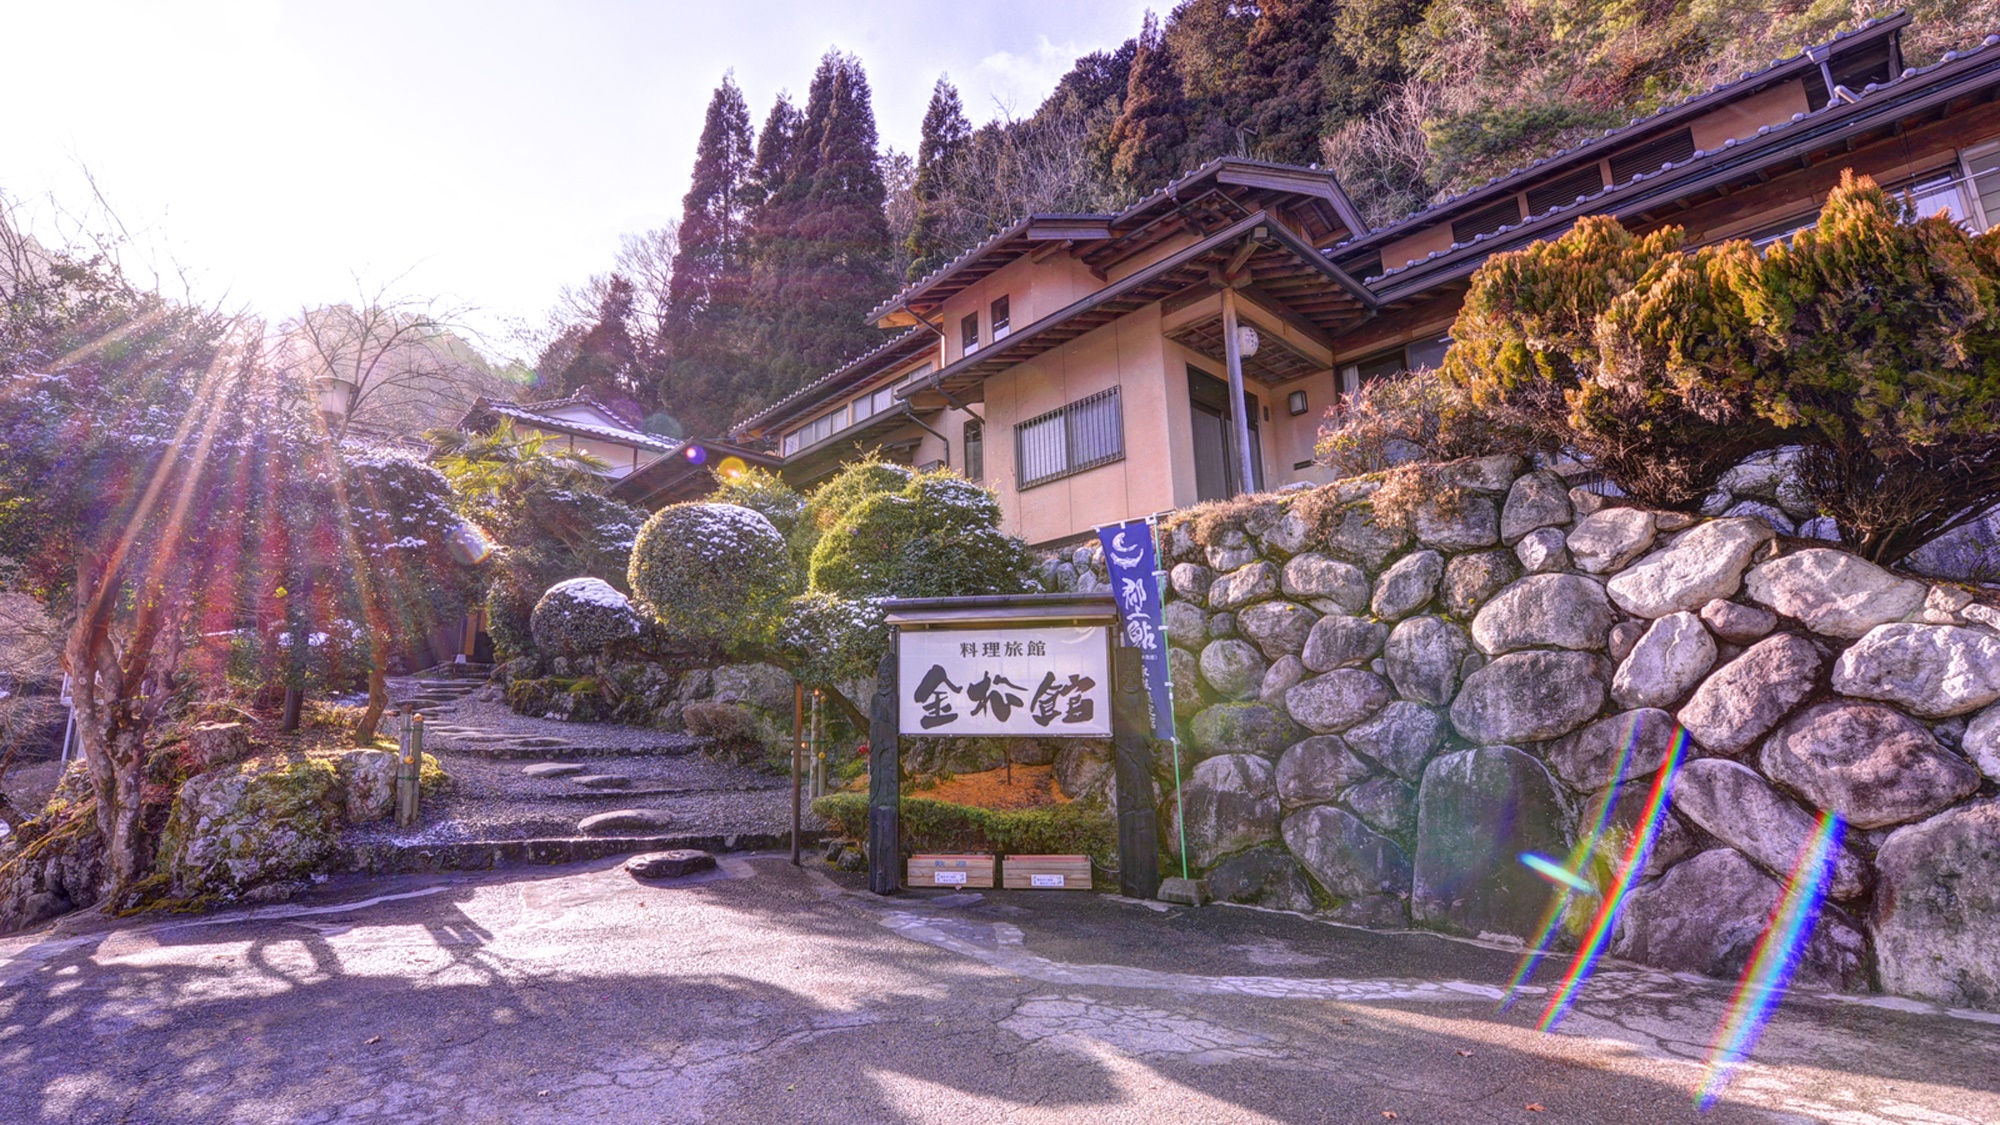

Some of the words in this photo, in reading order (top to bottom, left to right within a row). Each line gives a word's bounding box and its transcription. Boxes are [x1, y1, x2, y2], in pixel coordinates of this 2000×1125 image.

[1121, 577, 1158, 650] 郡上鮎
[960, 640, 1046, 658] 料理旅館
[914, 664, 1096, 730] 金松館
